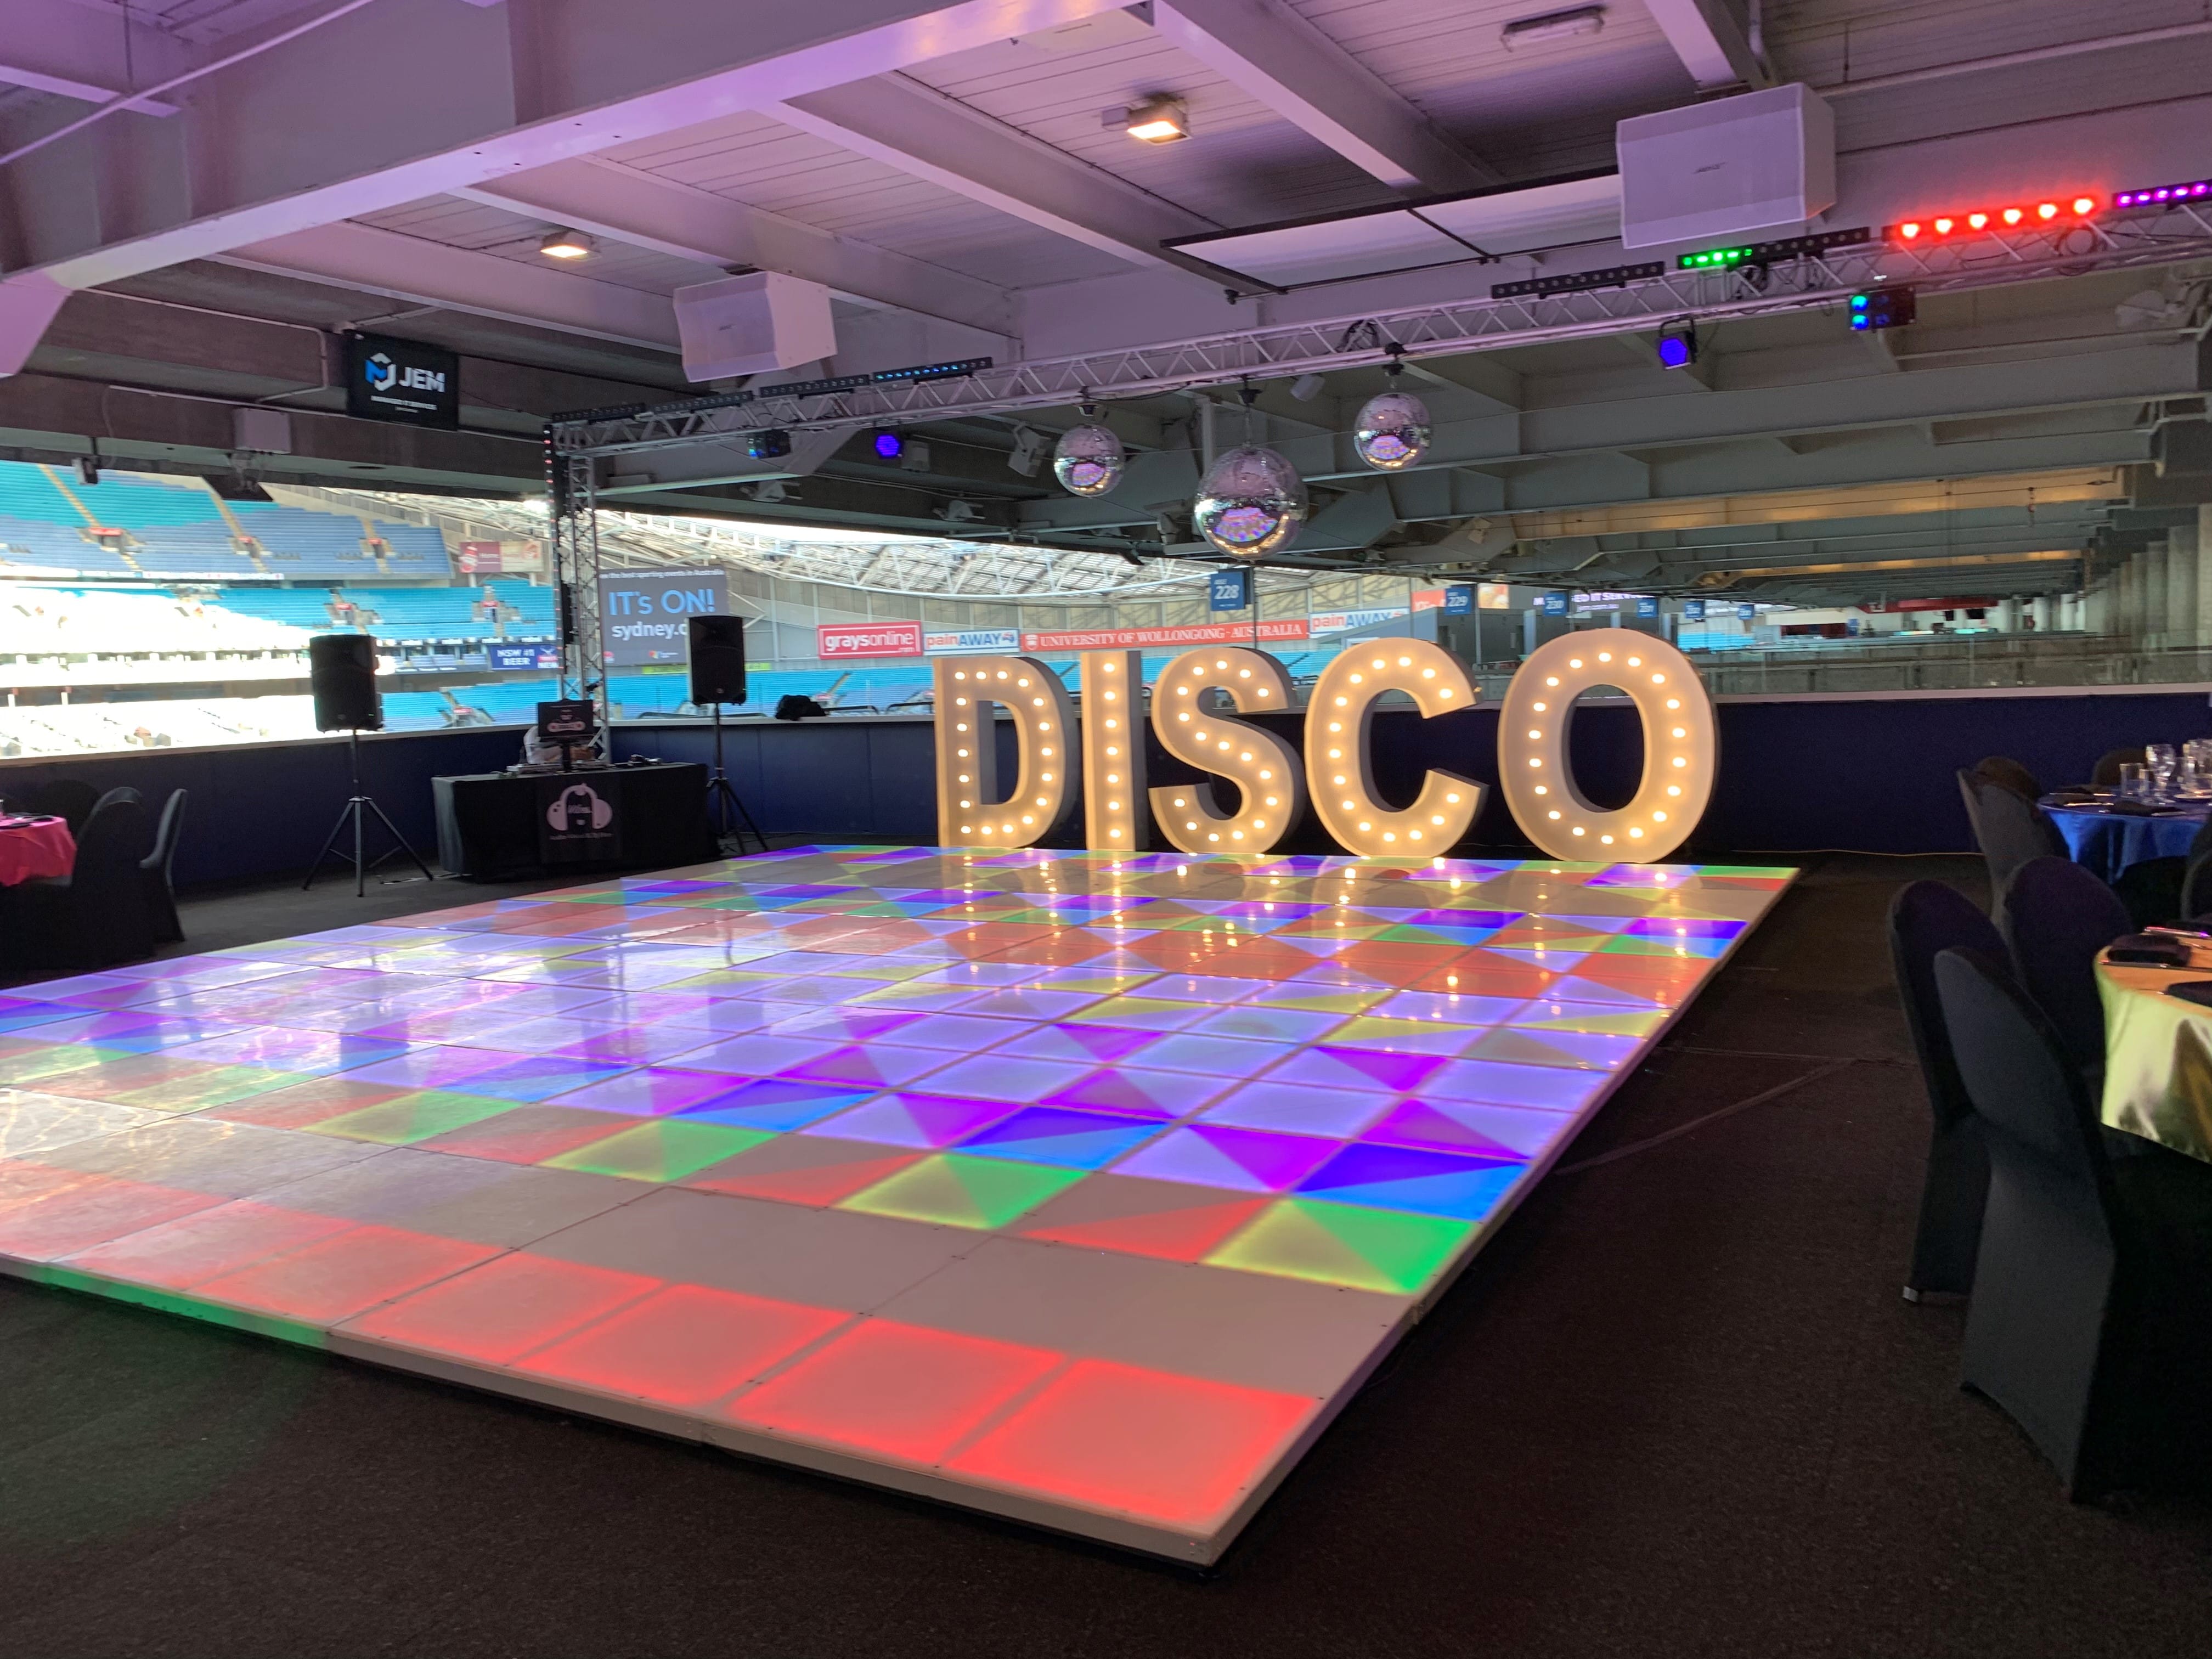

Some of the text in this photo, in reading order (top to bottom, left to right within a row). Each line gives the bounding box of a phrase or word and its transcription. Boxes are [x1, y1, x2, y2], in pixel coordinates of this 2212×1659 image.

[398, 366, 445, 393] JEM
[608, 589, 716, 616] IT's ON!
[1214, 584, 1240, 600] 228
[825, 631, 915, 651] graysonline
[927, 633, 1002, 648] painAWAY
[1040, 624, 1303, 647] UNIVERSITY OF WOLLONGONG AUSTRALIA
[503, 657, 531, 665] BEER
[933, 628, 1717, 864] DISCO
